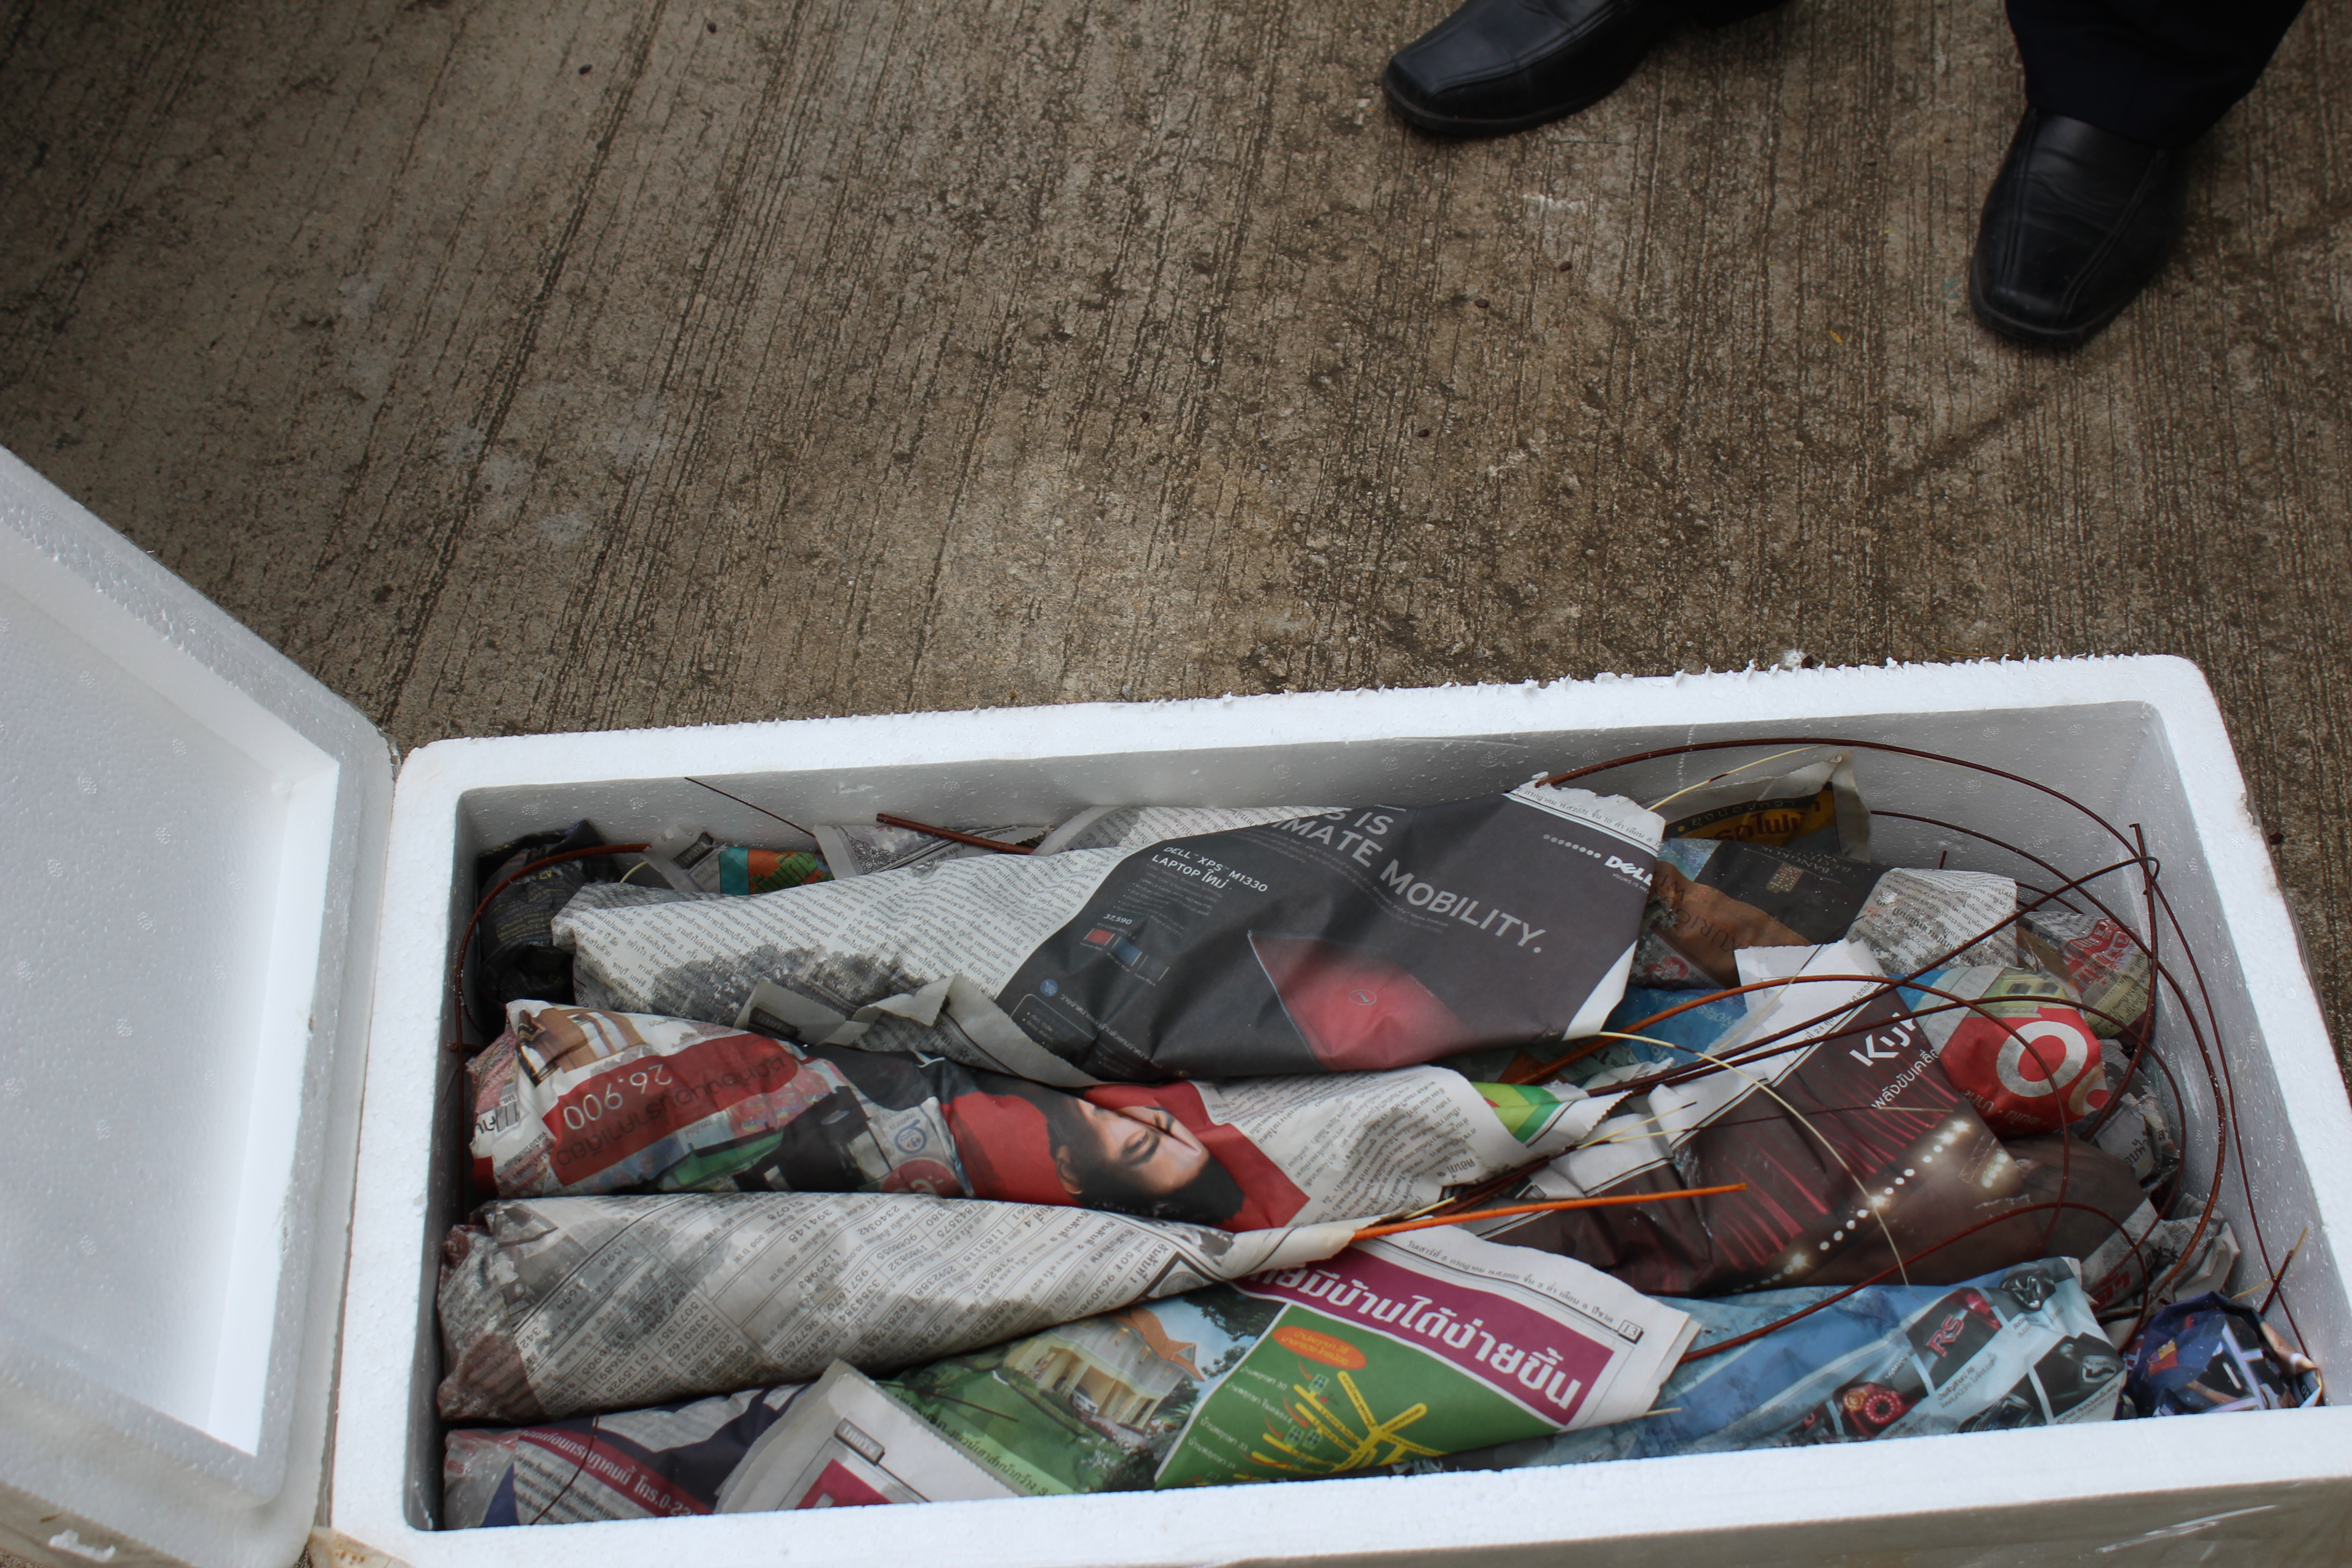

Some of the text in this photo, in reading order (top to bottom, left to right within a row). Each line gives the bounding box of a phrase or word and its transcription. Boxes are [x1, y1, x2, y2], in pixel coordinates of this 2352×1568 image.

[1152, 854, 1201, 877] LAPTOP
[1163, 847, 1191, 859] DELL
[1228, 870, 1268, 892] M1330
[1379, 858, 1545, 953] MOBILITY.
[787, 1205, 833, 1246] 394148
[604, 1300, 700, 1396] 5071357 5115928
[664, 1311, 711, 1358] 4380162
[676, 1322, 722, 1368] 3509743
[1921, 1310, 1972, 1361] RS
